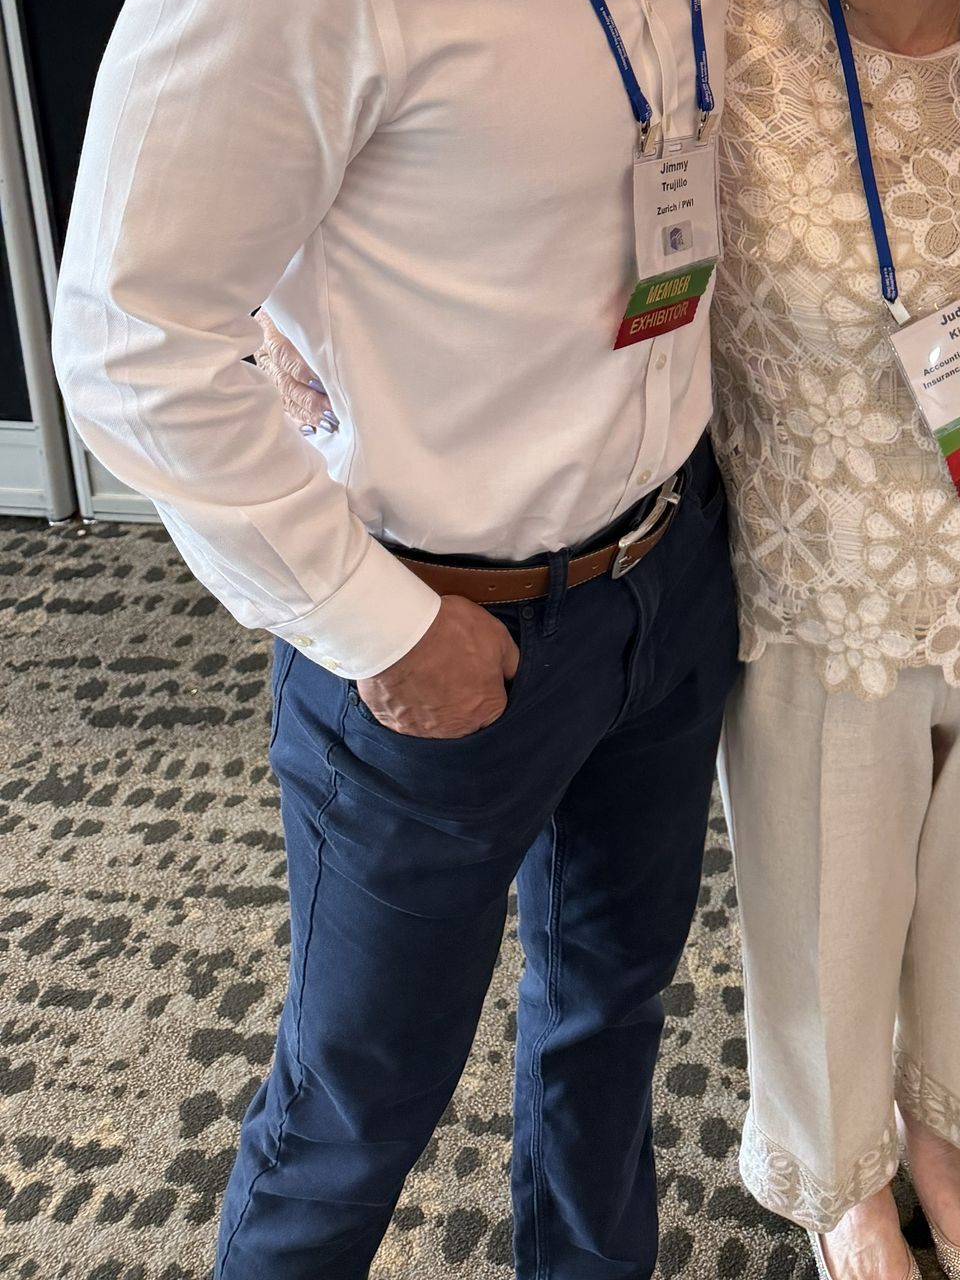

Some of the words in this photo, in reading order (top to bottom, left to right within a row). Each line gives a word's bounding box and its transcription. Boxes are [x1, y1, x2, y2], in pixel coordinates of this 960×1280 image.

[660, 160, 689, 175] Jimmy
[661, 179, 688, 192] Trujillo
[657, 201, 678, 216] Zurich
[645, 274, 691, 305] MEMBER
[629, 300, 689, 335] EXHIBITOR
